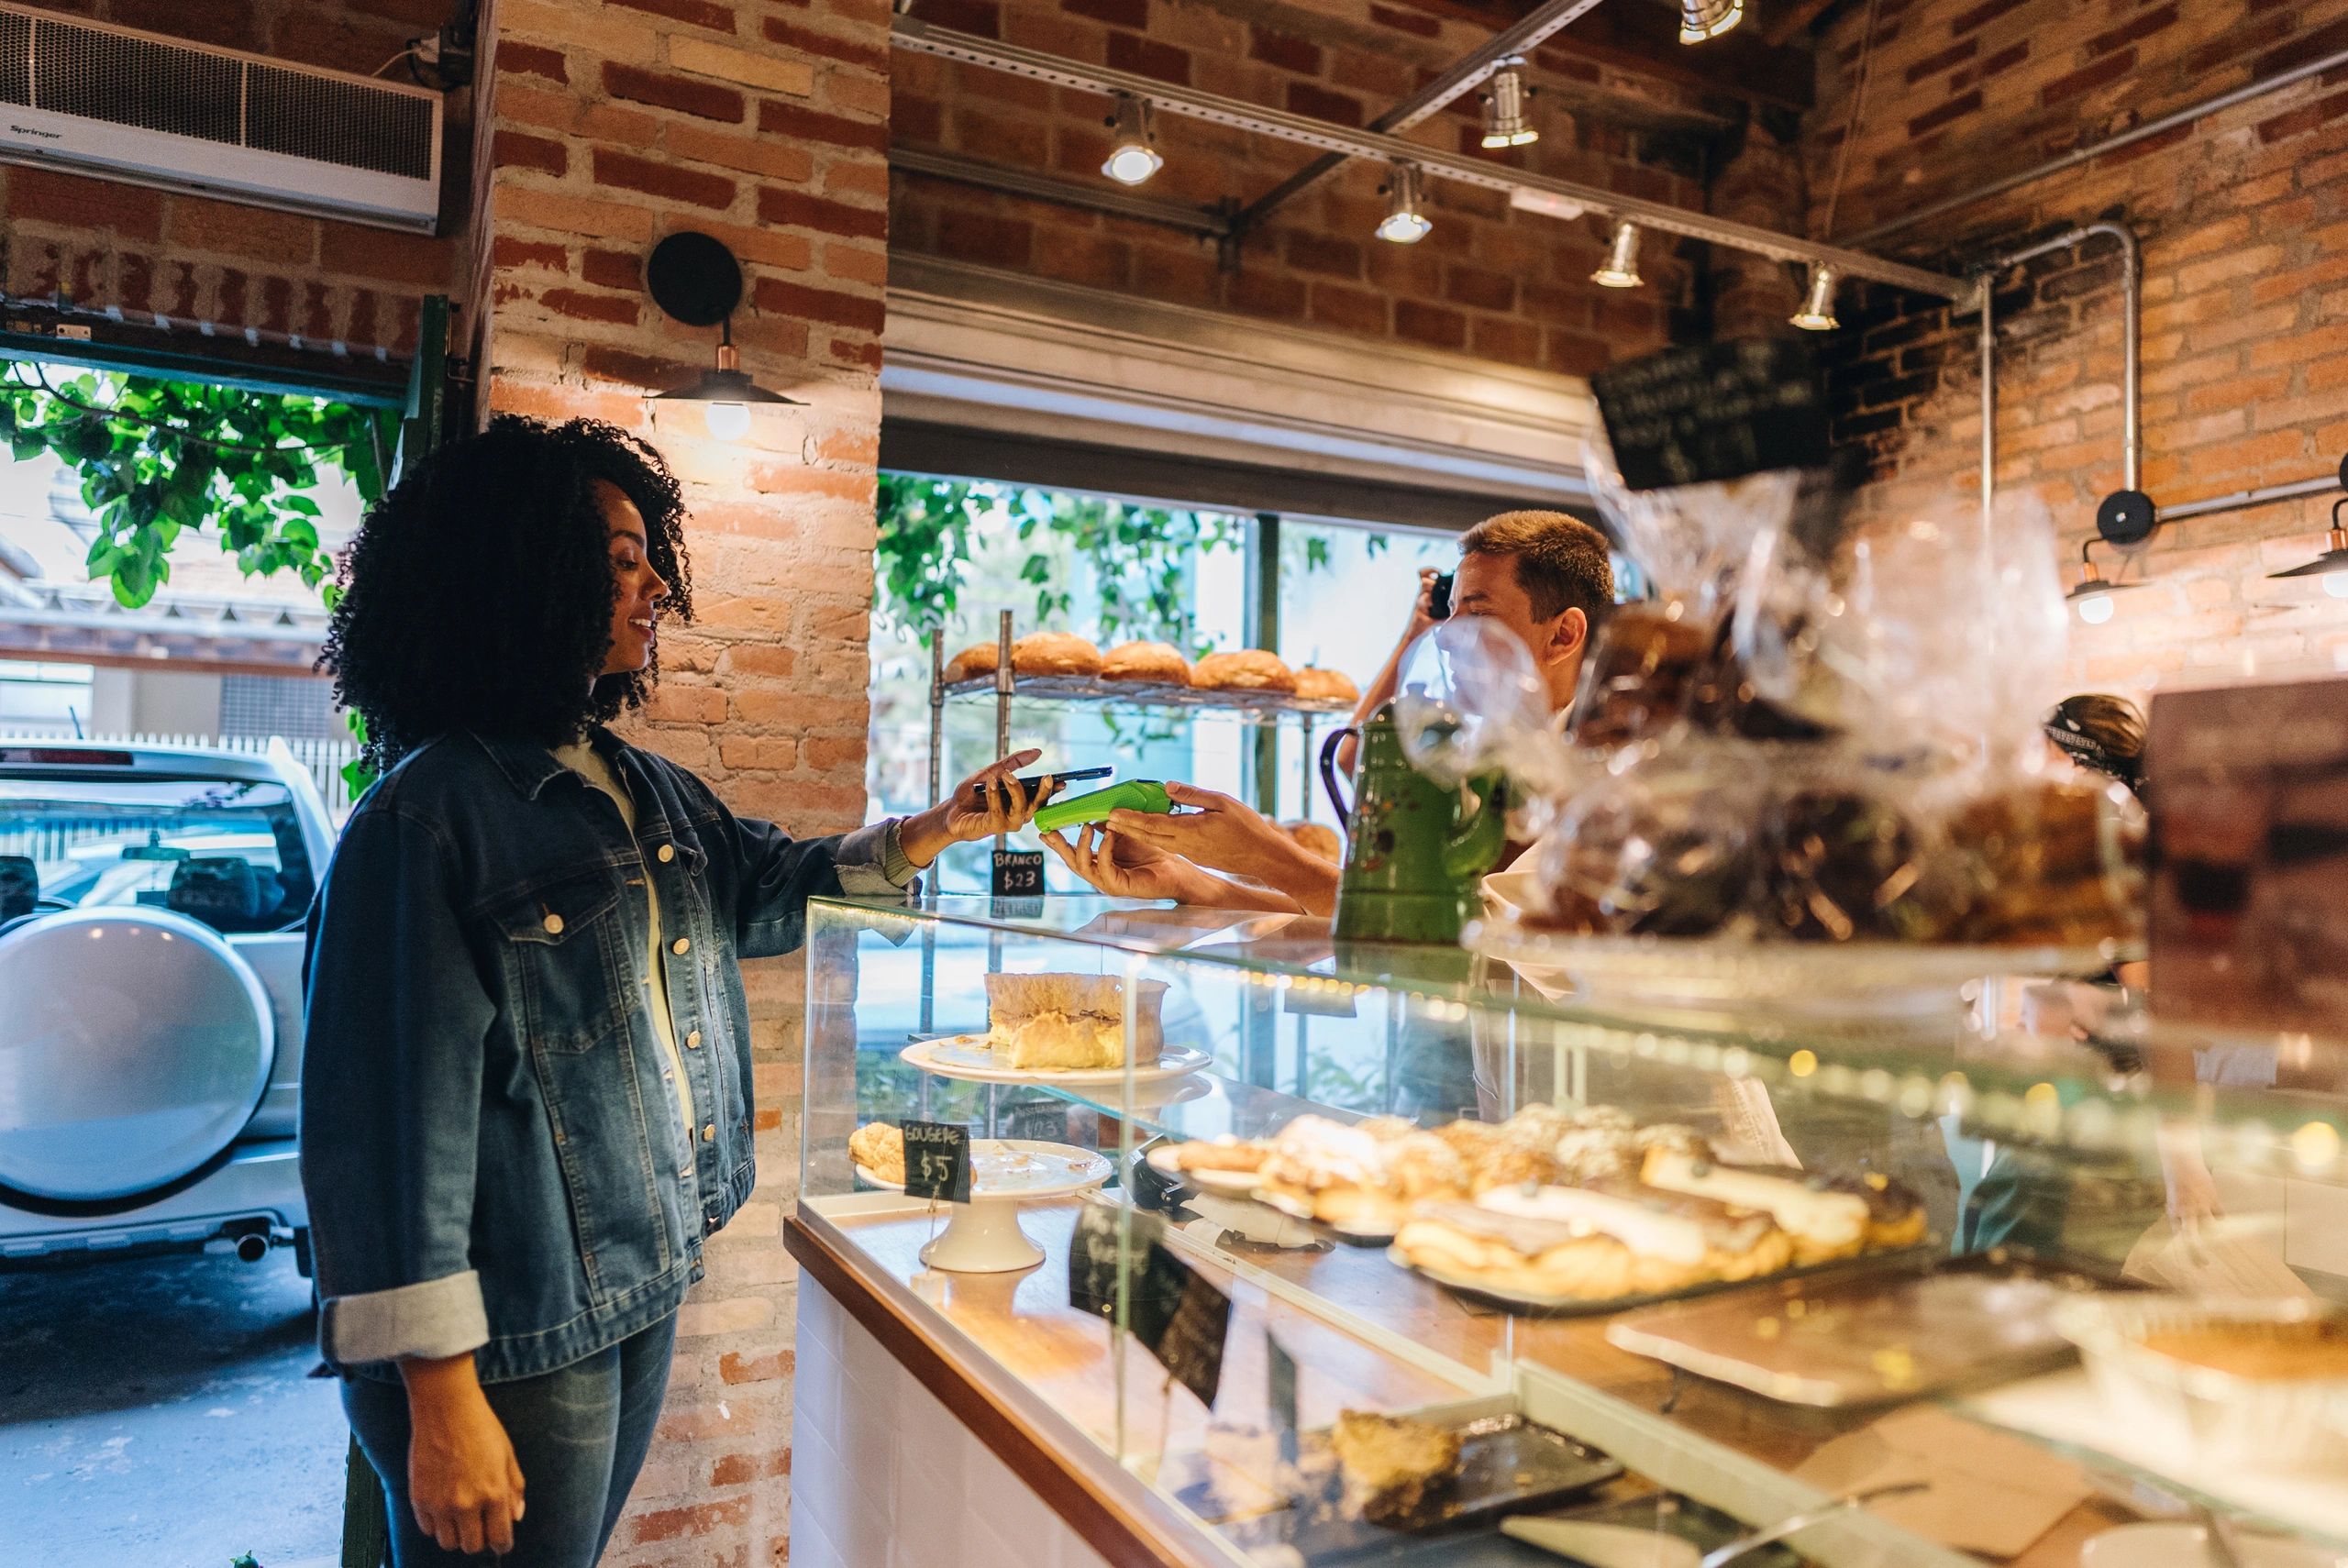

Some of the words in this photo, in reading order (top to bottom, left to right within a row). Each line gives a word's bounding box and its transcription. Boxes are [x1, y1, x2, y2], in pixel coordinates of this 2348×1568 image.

[10, 125, 62, 138] Springer
[993, 853, 1042, 867] BRANCO
[920, 1149, 954, 1182] $5
